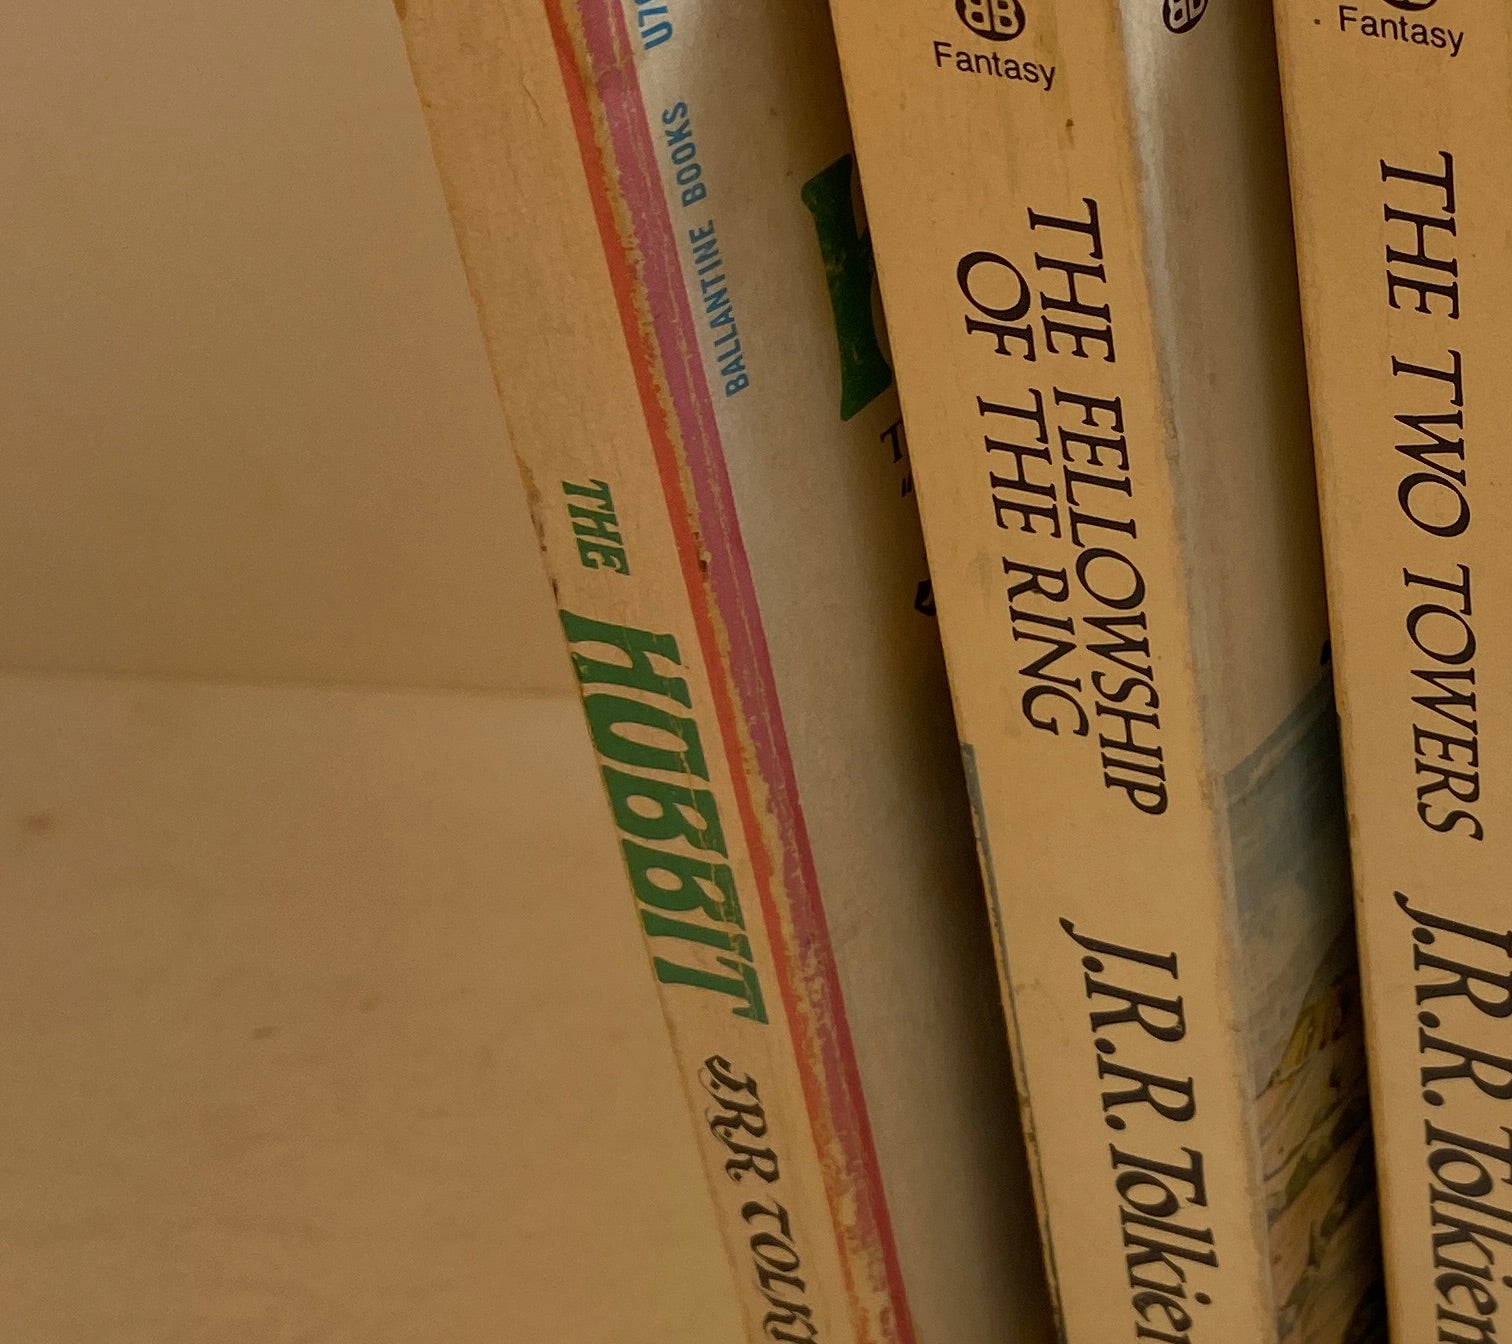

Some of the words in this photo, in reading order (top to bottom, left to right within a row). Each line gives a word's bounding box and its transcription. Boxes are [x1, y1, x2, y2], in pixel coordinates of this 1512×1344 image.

[933, 42, 1055, 91] Fantasy
[1338, 5, 1464, 57] Fantasy
[662, 102, 708, 207] BOOKS
[1380, 151, 1460, 320] THE
[689, 220, 750, 398] BALLANTINE
[957, 250, 1036, 362] OF
[1027, 197, 1117, 363] THE
[562, 479, 630, 575] THE
[976, 388, 1062, 539] THE
[1391, 349, 1471, 537] TWO
[1002, 556, 1089, 737] RING
[1053, 386, 1168, 815] FELLOWSHIP
[1403, 563, 1484, 841] TOWERS
[559, 609, 769, 1025] HOBBIT
[1059, 917, 1197, 1130] J.R.R.
